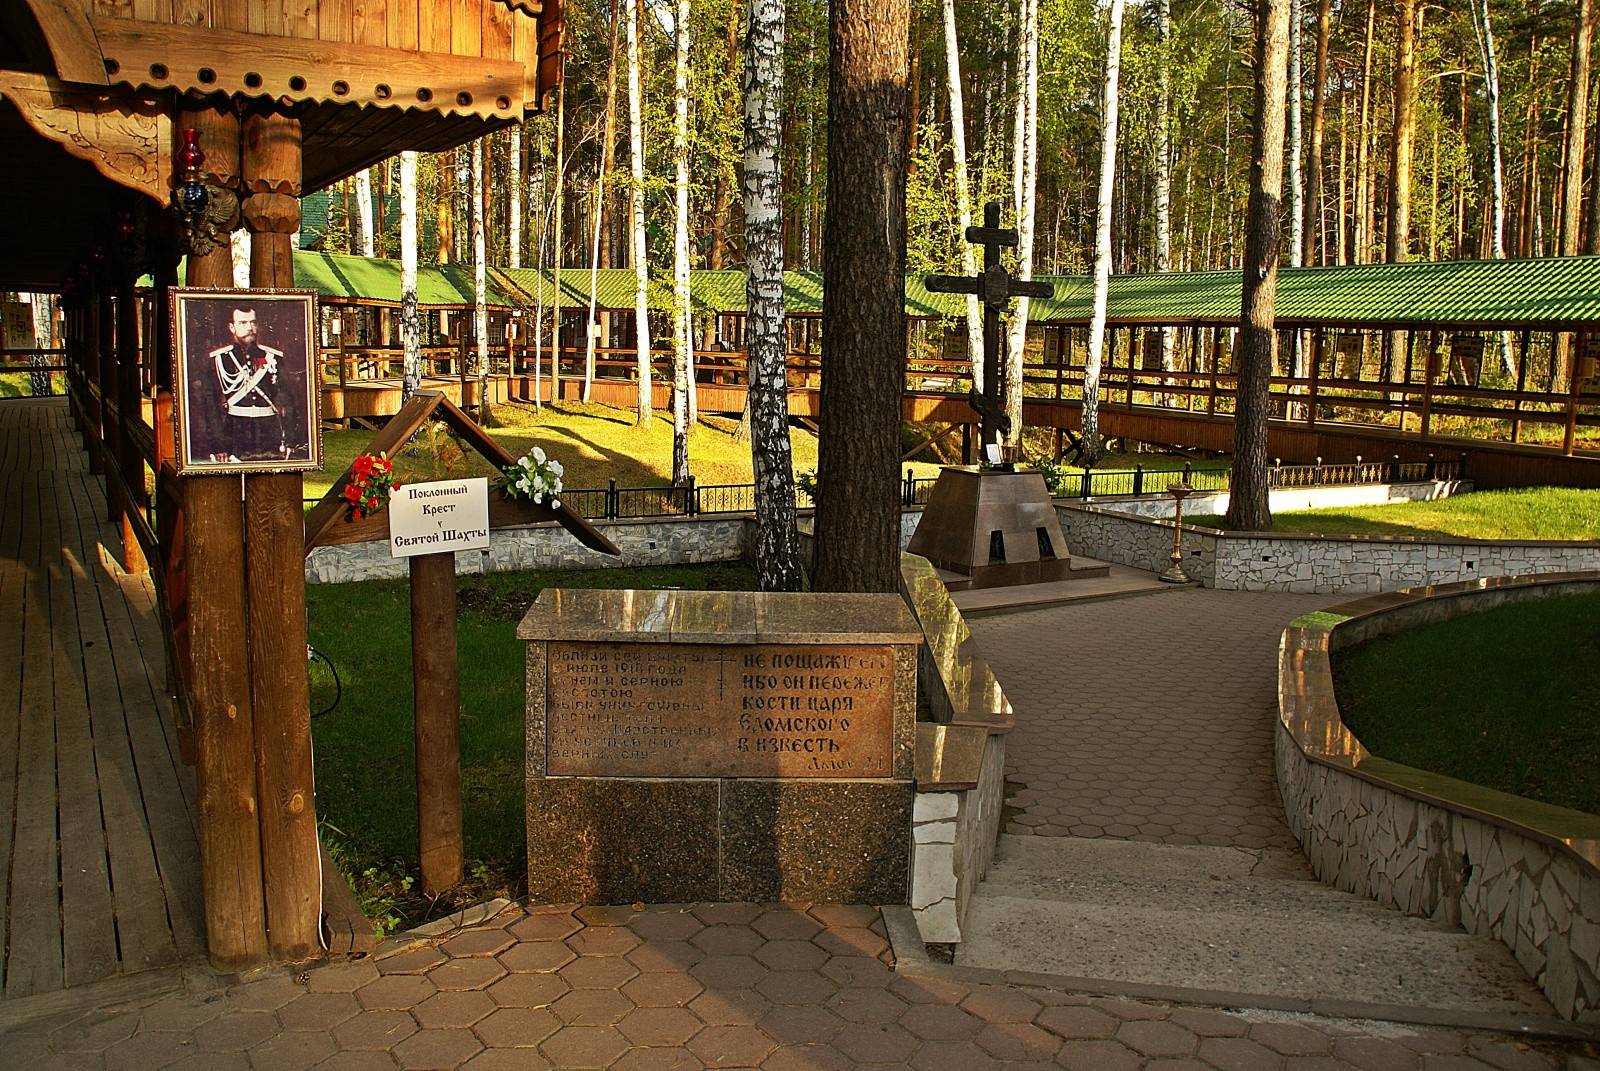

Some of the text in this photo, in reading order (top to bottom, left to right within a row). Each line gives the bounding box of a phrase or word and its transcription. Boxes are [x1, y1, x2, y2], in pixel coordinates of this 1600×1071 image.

[408, 485, 468, 499] Поклонный
[422, 504, 456, 517] Крест
[394, 529, 487, 547] Святой Шахты
